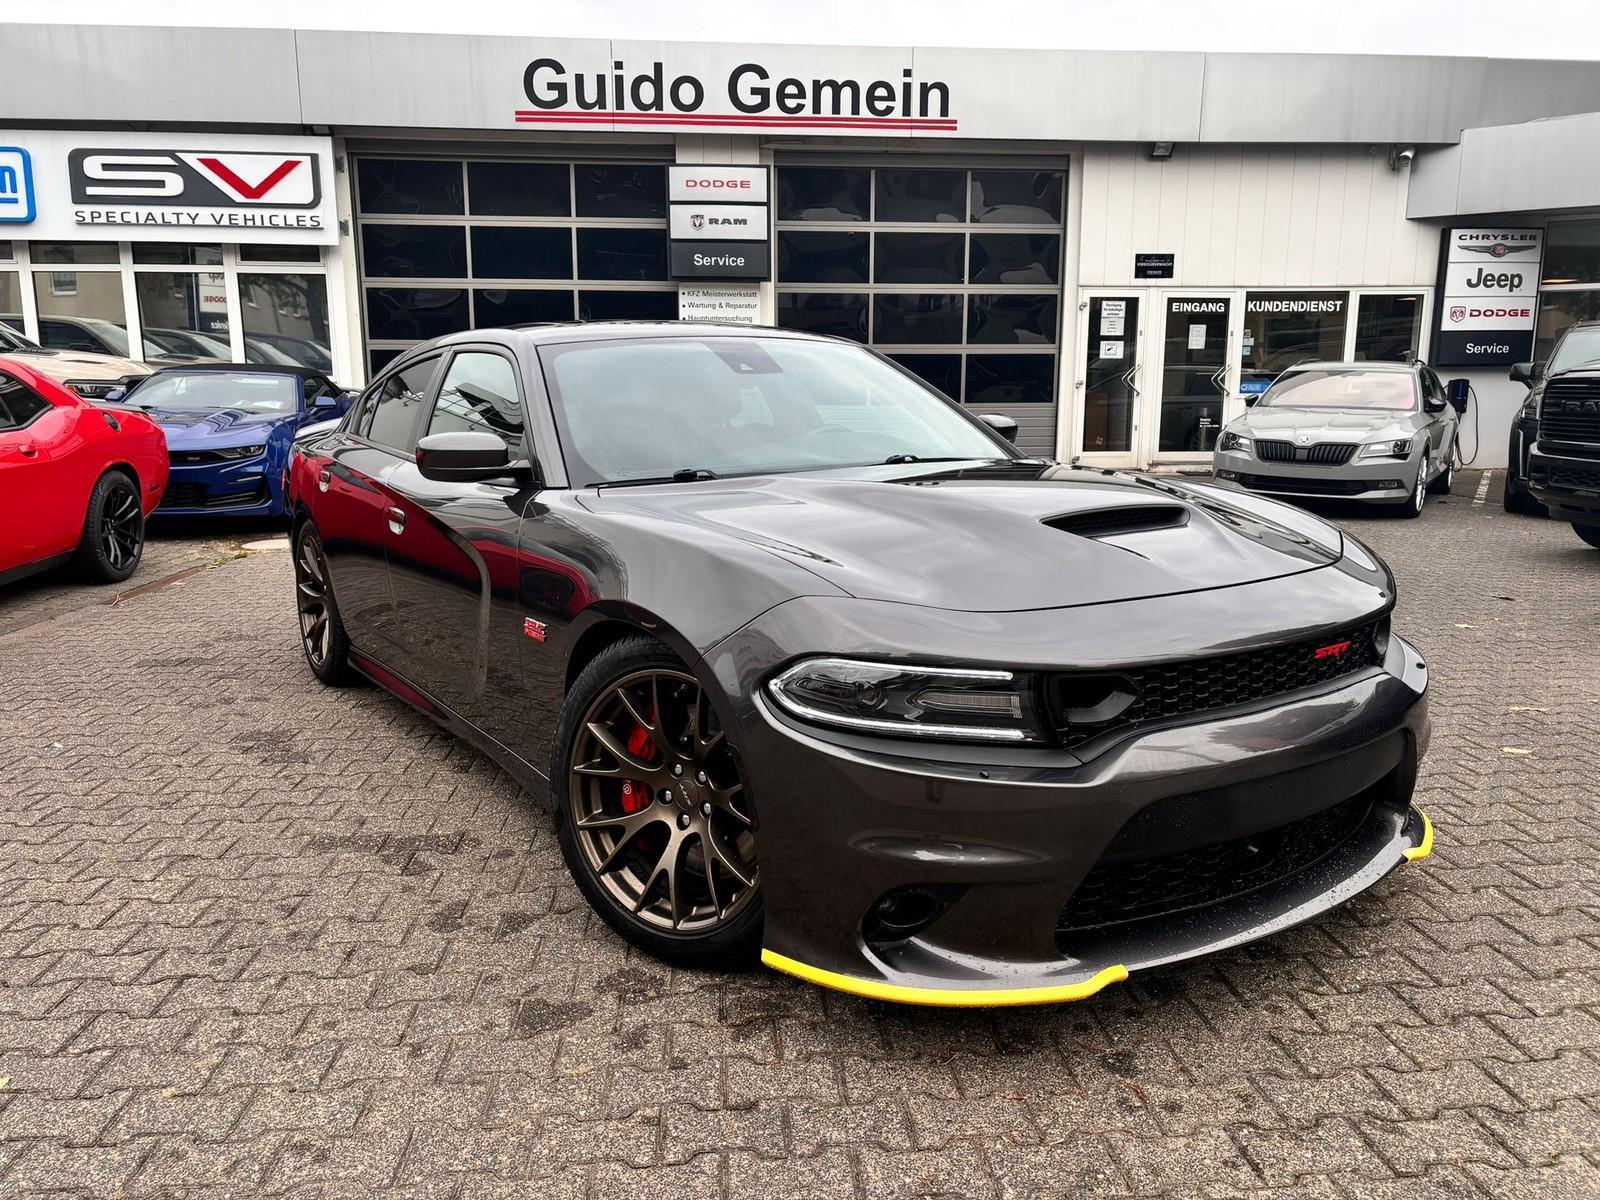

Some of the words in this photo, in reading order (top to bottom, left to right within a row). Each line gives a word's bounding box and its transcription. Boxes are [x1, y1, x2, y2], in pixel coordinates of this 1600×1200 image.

[523, 58, 705, 112] Guido
[728, 63, 950, 118] Gemein
[685, 179, 751, 189] DODGE
[74, 210, 199, 226] SPECIALTY
[210, 213, 321, 228] VEHICLES
[708, 217, 748, 226] RAM
[693, 253, 745, 267] Service
[1466, 267, 1523, 292] Jeep
[702, 290, 757, 298] Meisterwerkstatt
[687, 302, 716, 310] Wartung
[725, 302, 757, 310] Reparatur
[1172, 302, 1225, 313] EINGANG
[1247, 300, 1343, 312] KUNDENDIENST
[1469, 309, 1530, 317] DODGE
[1465, 343, 1510, 354] Service
